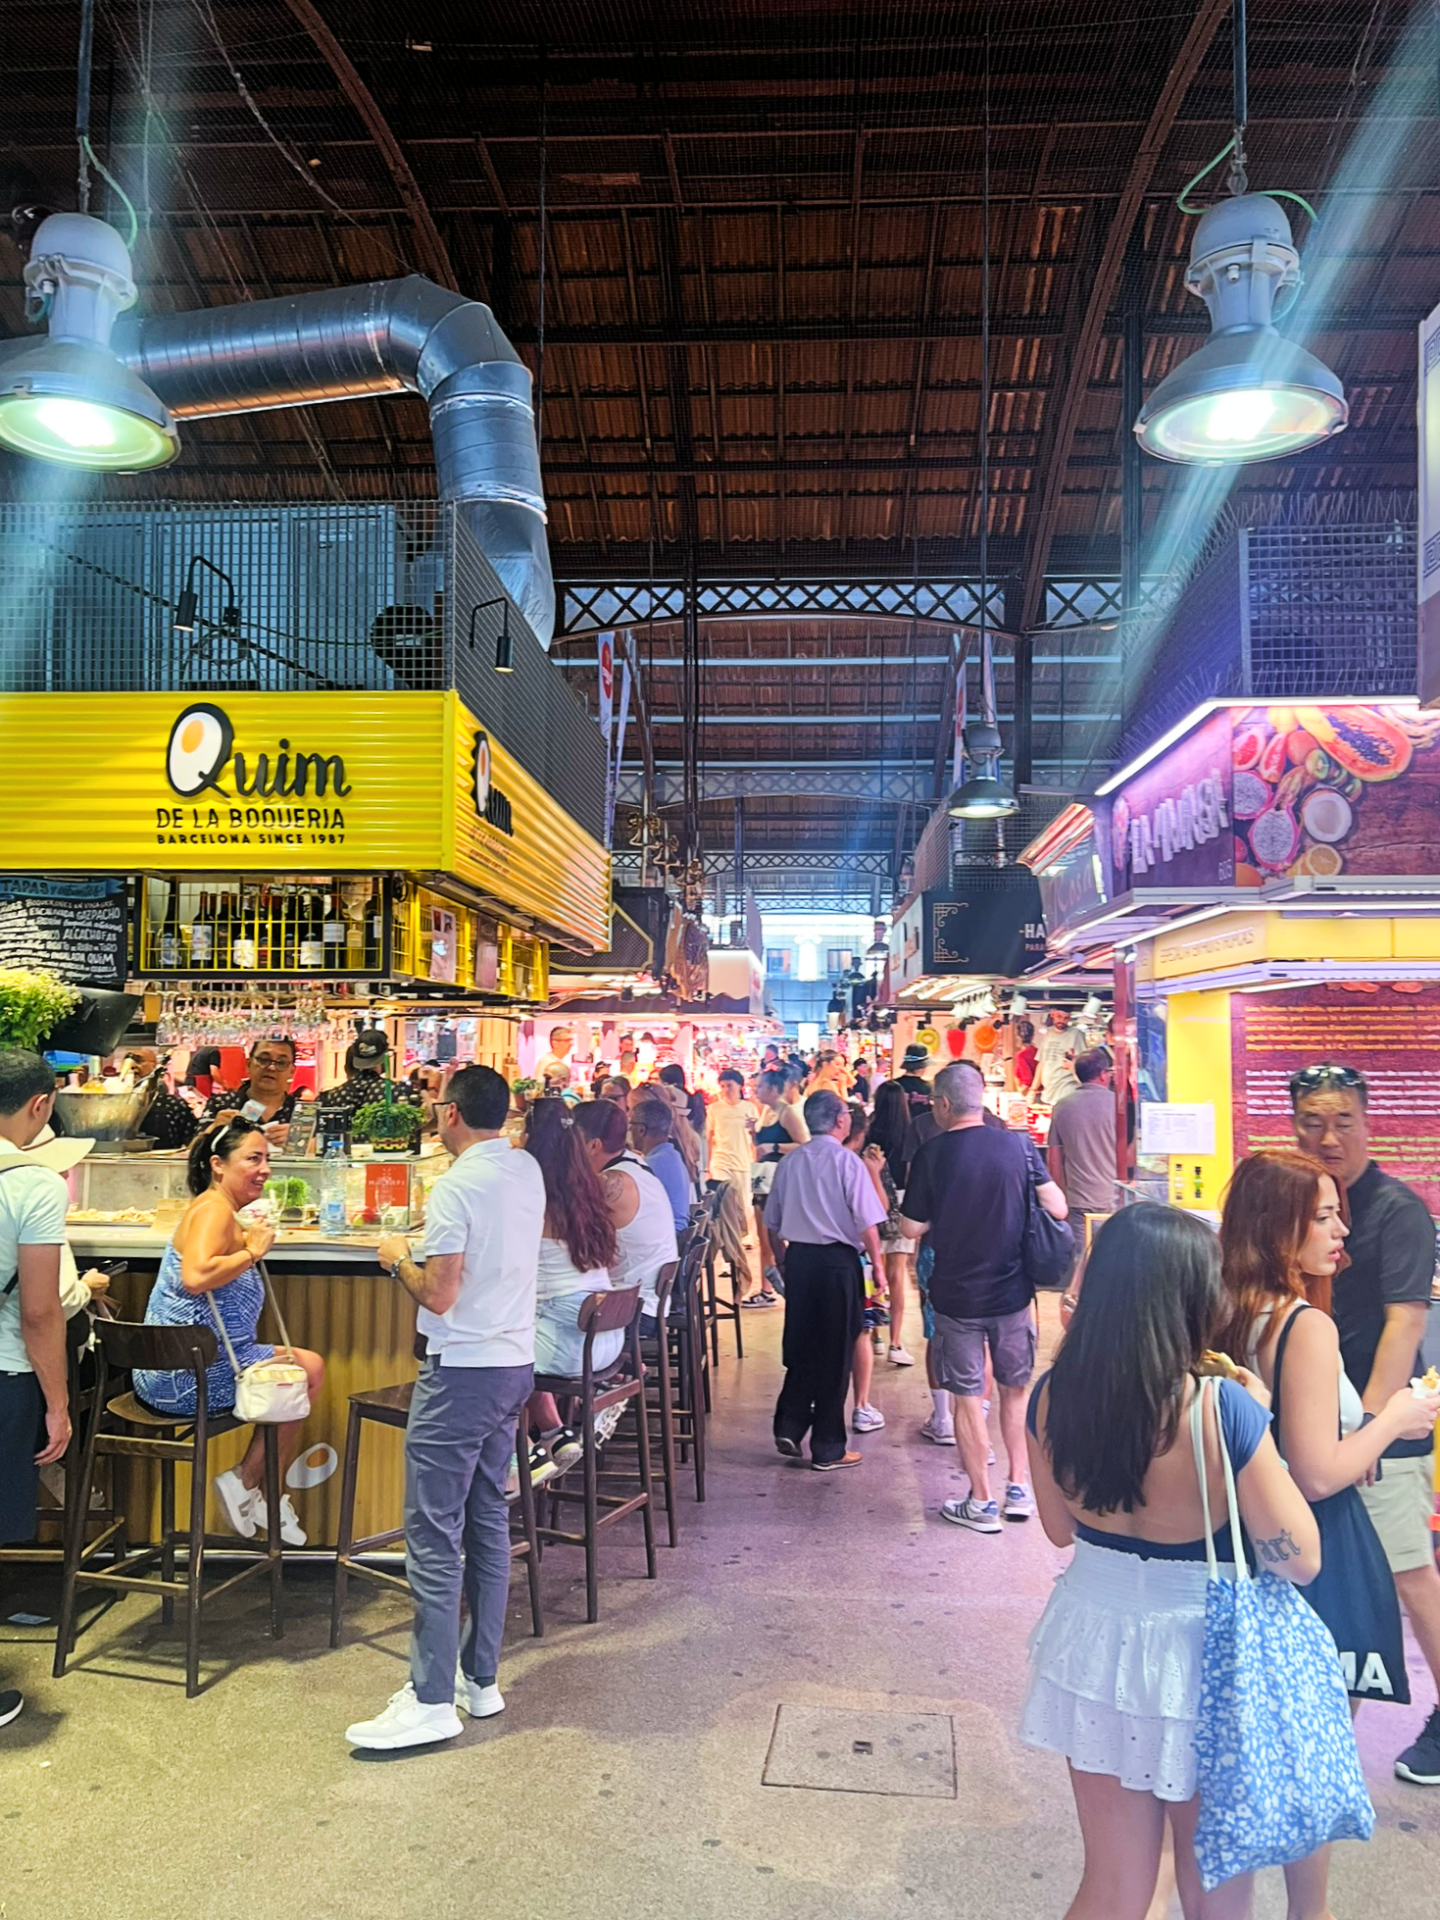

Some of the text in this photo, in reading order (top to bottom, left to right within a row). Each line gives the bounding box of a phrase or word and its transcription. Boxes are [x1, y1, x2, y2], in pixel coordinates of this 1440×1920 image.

[166, 702, 352, 798] Quim
[157, 808, 345, 830] DE LA BOQUERIA
[157, 834, 345, 844] BARCELONA SINCE 1987
[1, 879, 49, 895] TAPAS
[76, 907, 121, 920] GAZPACHO
[62, 928, 117, 941] ALCACHOFAS
